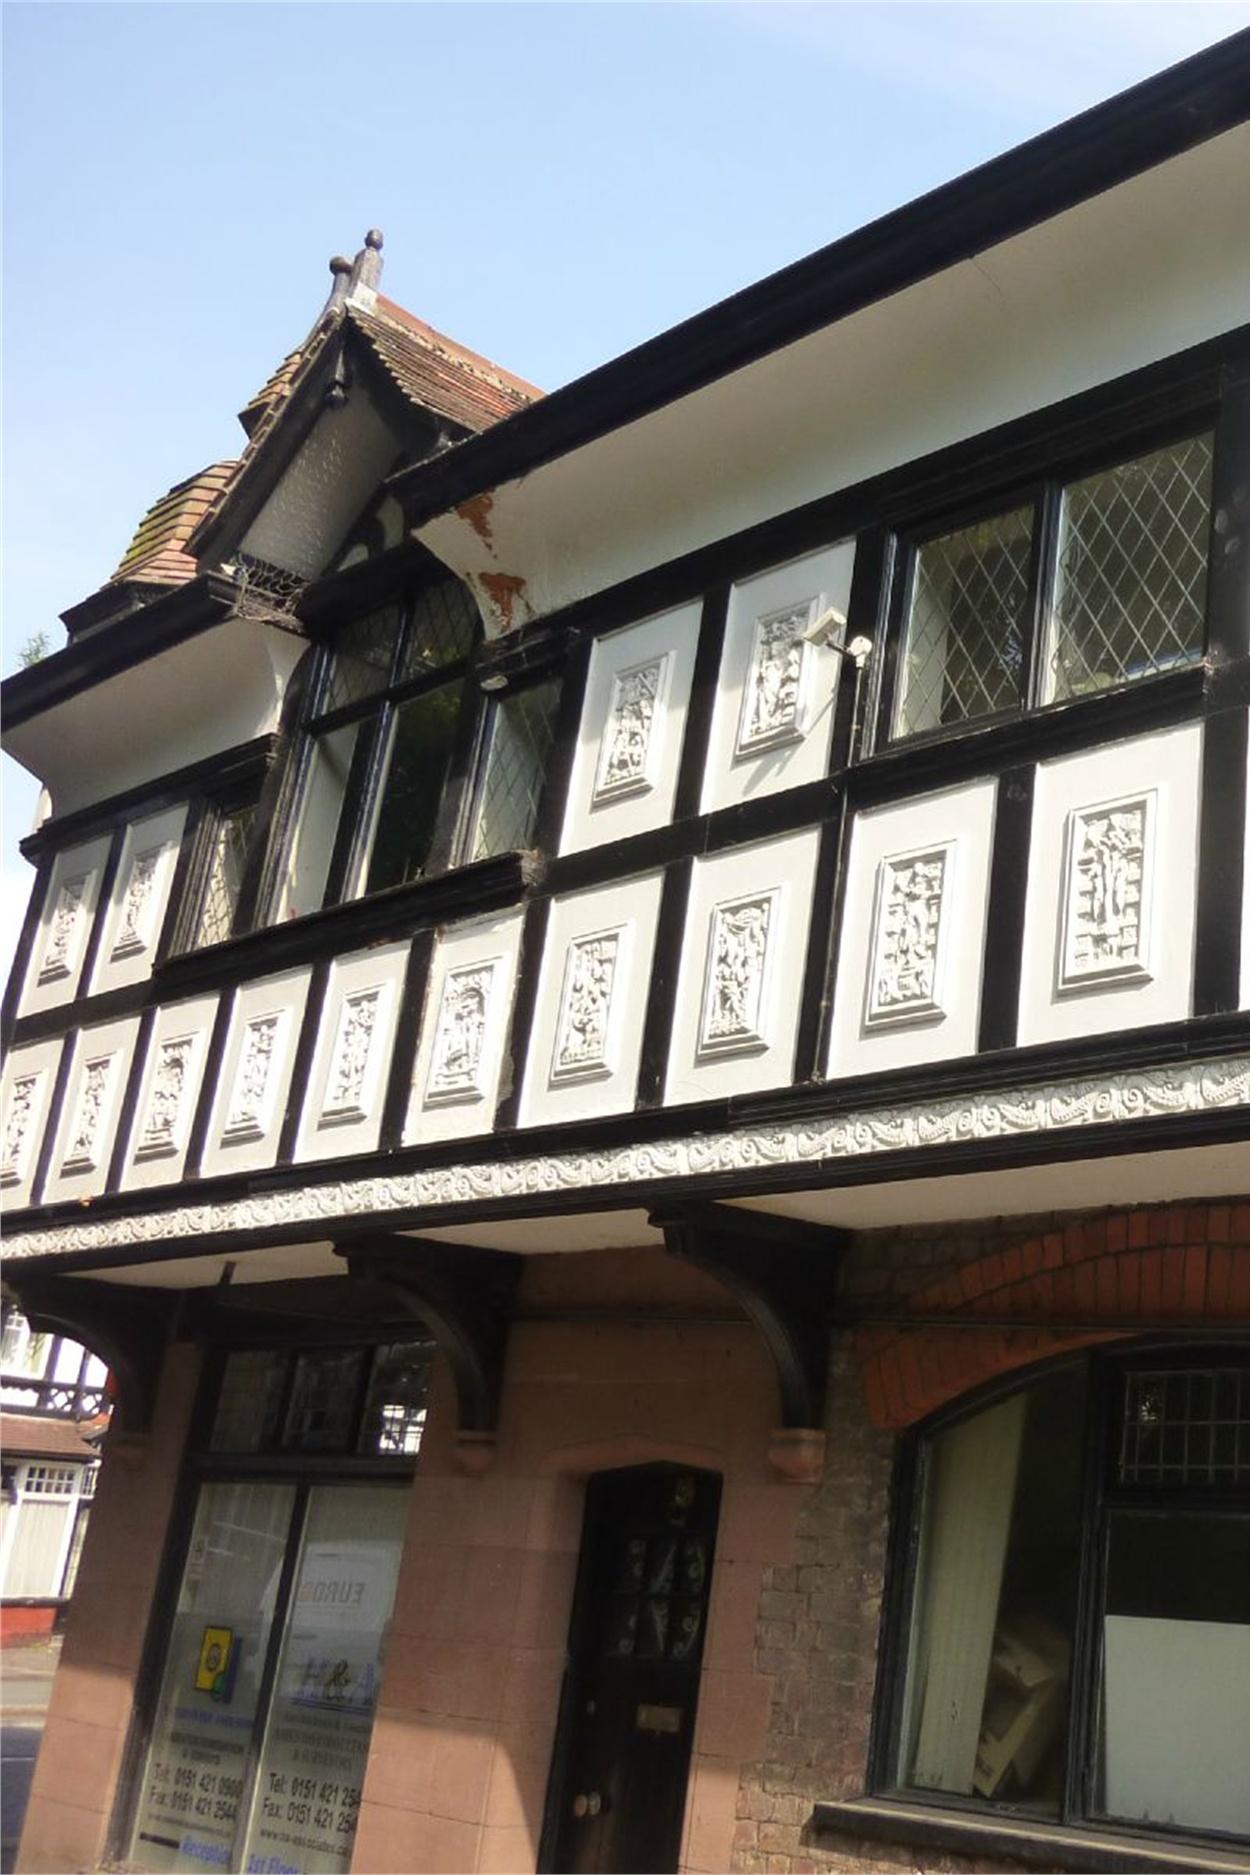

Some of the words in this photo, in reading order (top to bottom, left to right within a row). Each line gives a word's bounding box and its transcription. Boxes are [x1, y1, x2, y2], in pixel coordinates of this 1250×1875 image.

[291, 1776, 317, 1800] 0151
[319, 1782, 340, 1804] 421
[287, 1801, 312, 1826] 0151
[314, 1807, 334, 1830] 421
